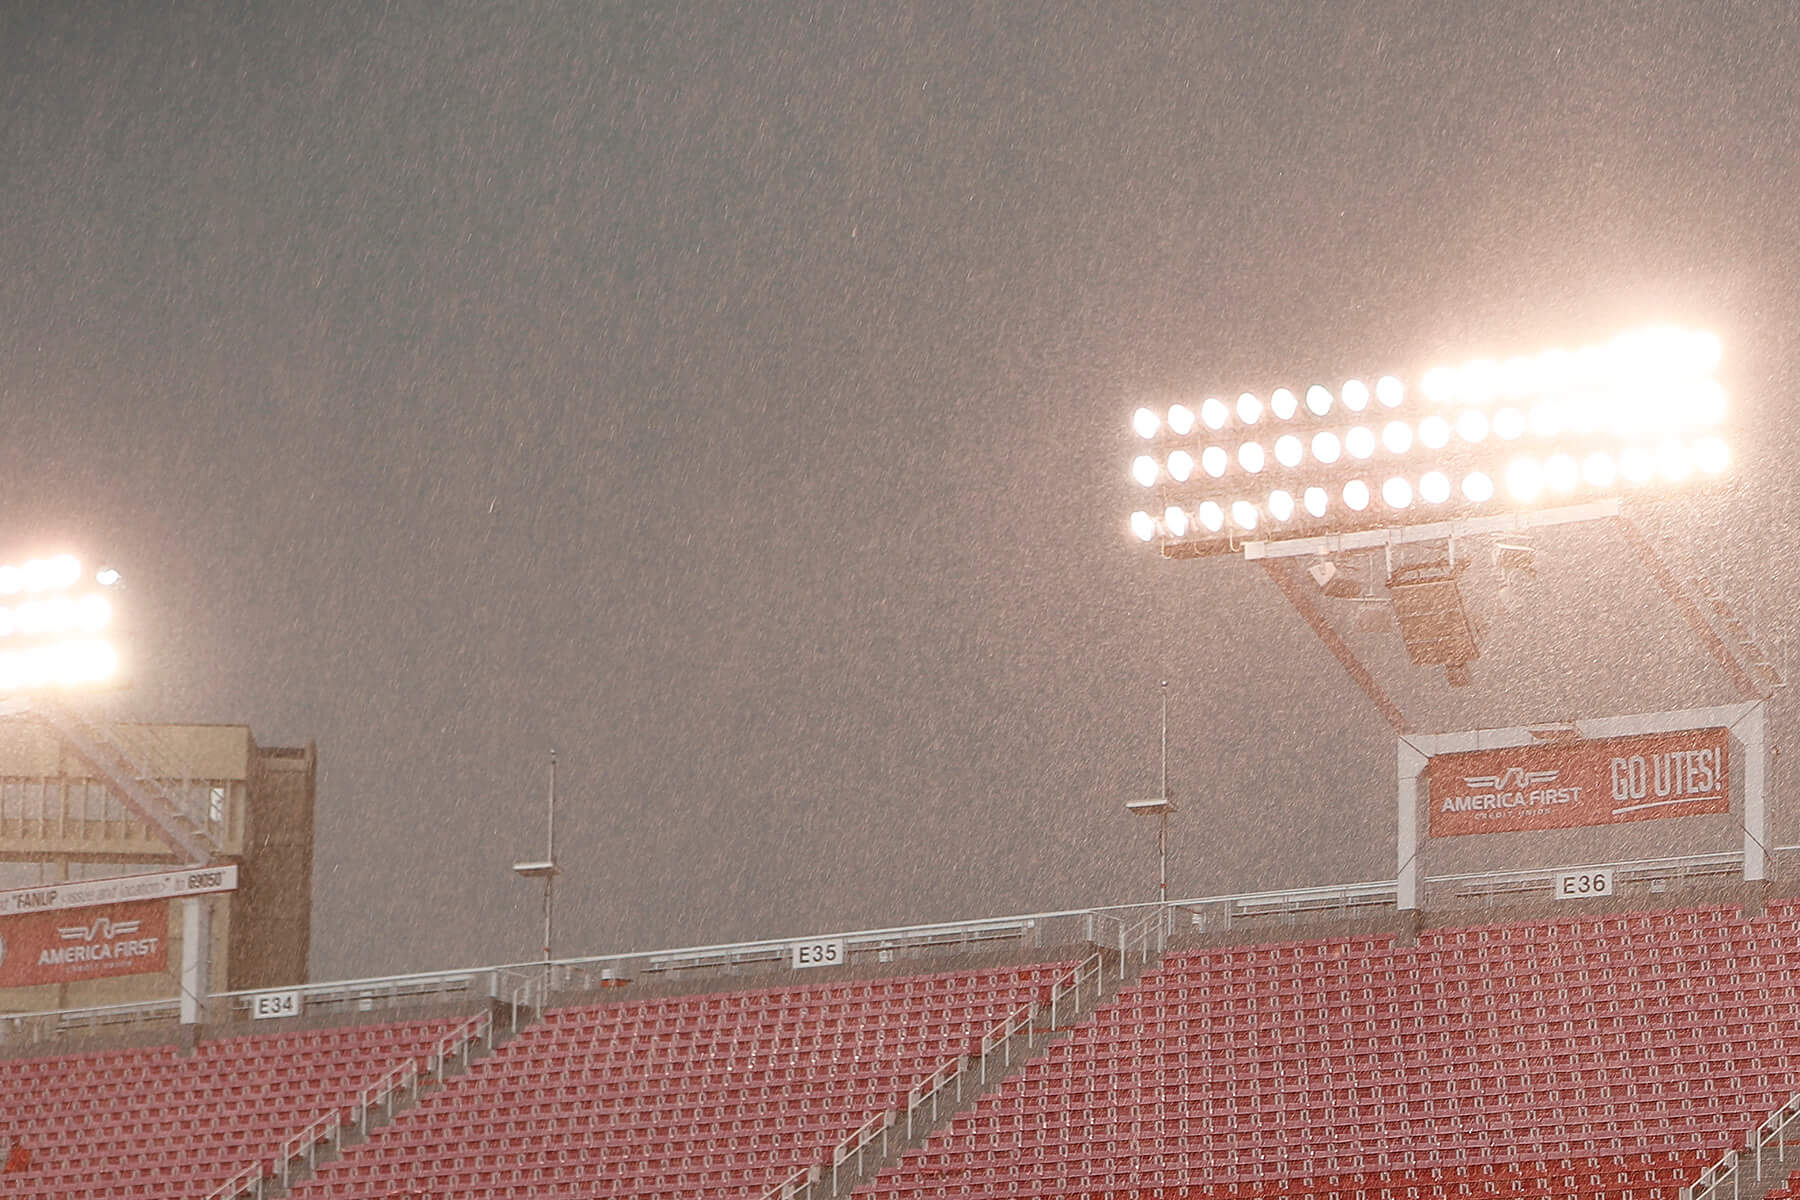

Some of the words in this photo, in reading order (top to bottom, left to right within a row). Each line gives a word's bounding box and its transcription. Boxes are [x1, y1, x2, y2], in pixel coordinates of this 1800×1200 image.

[1610, 755, 1647, 802] GO
[1653, 747, 1722, 798] UTES!
[1441, 790, 1528, 814] AMERICA
[1530, 787, 1583, 806] FIRST
[1562, 873, 1606, 896] E36
[39, 944, 111, 966] AMERICA
[112, 937, 159, 958] FIRST
[799, 944, 836, 963] E35
[259, 997, 293, 1015] E34
